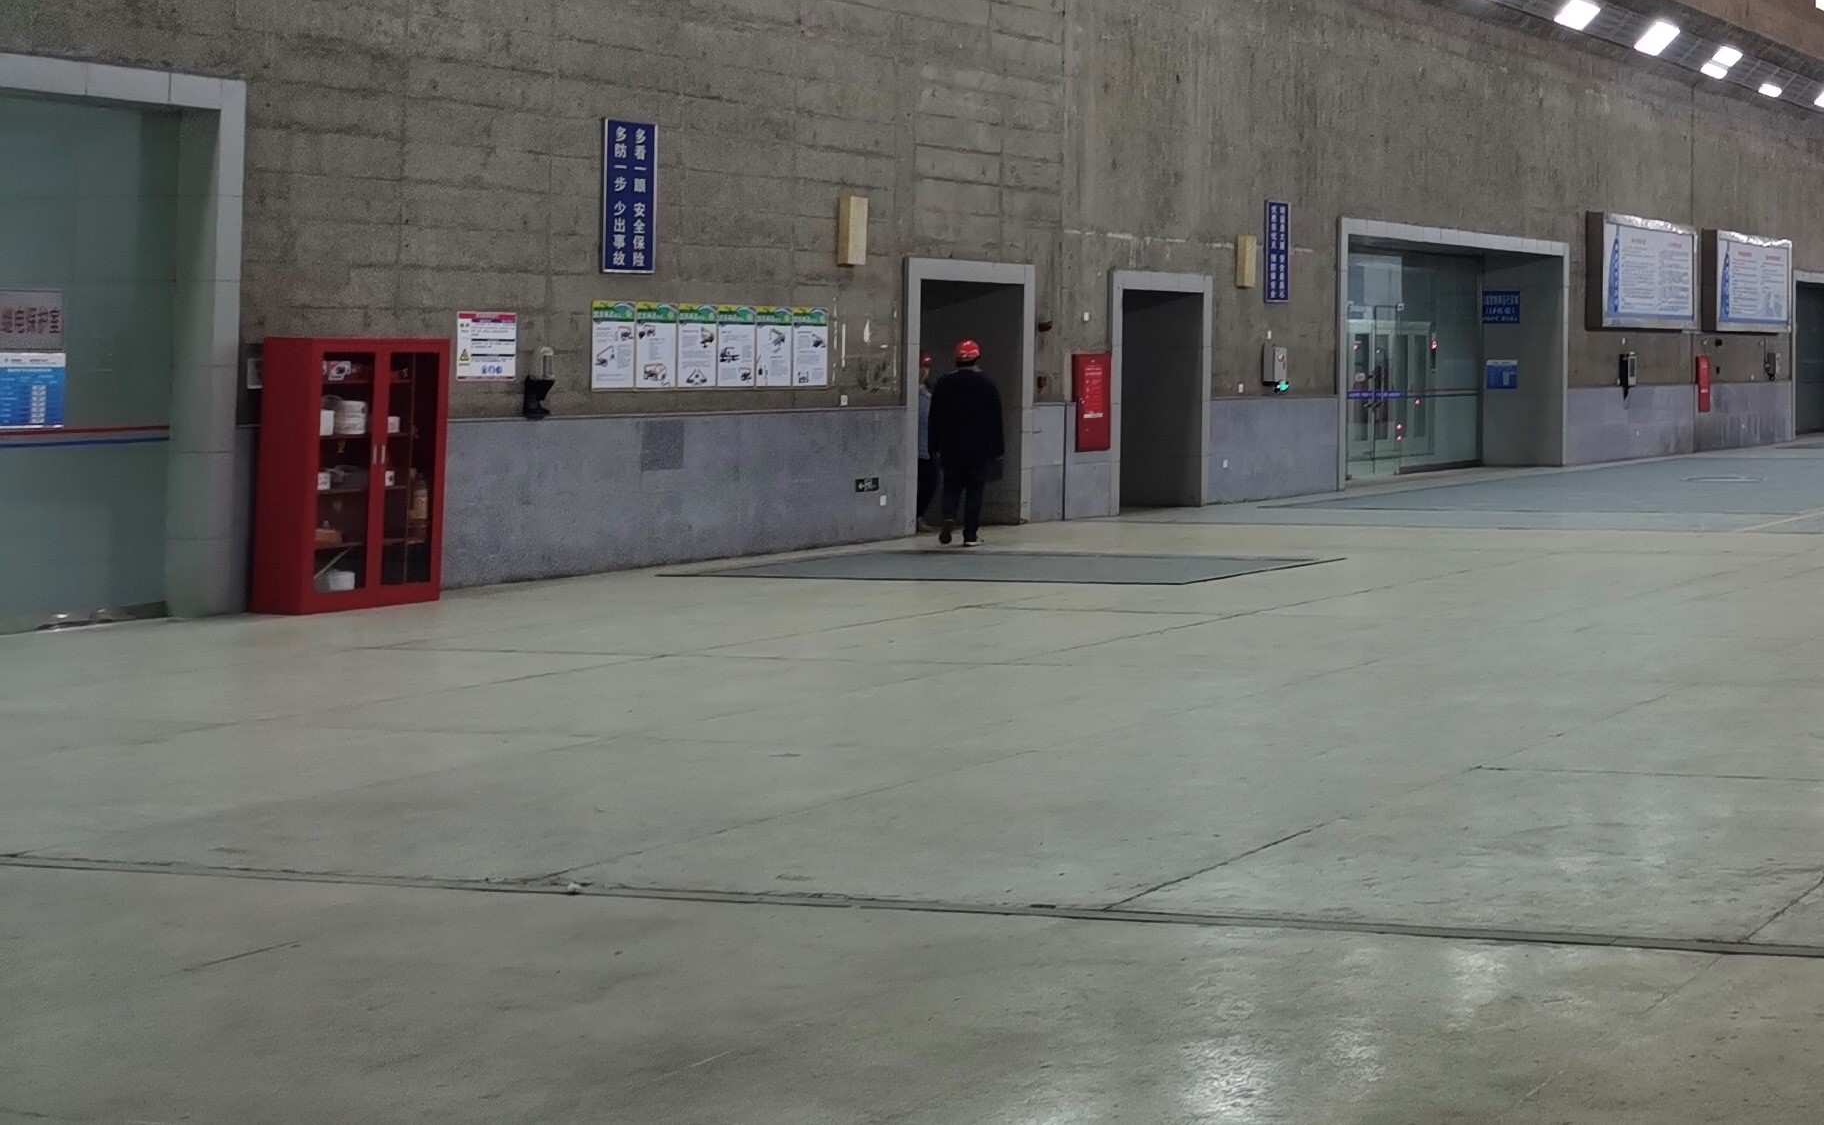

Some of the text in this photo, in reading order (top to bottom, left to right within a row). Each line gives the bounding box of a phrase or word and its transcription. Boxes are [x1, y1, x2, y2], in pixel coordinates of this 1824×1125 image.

[613, 126, 628, 266] 多防一步 少出事故
[632, 202, 646, 267] 安全保险
